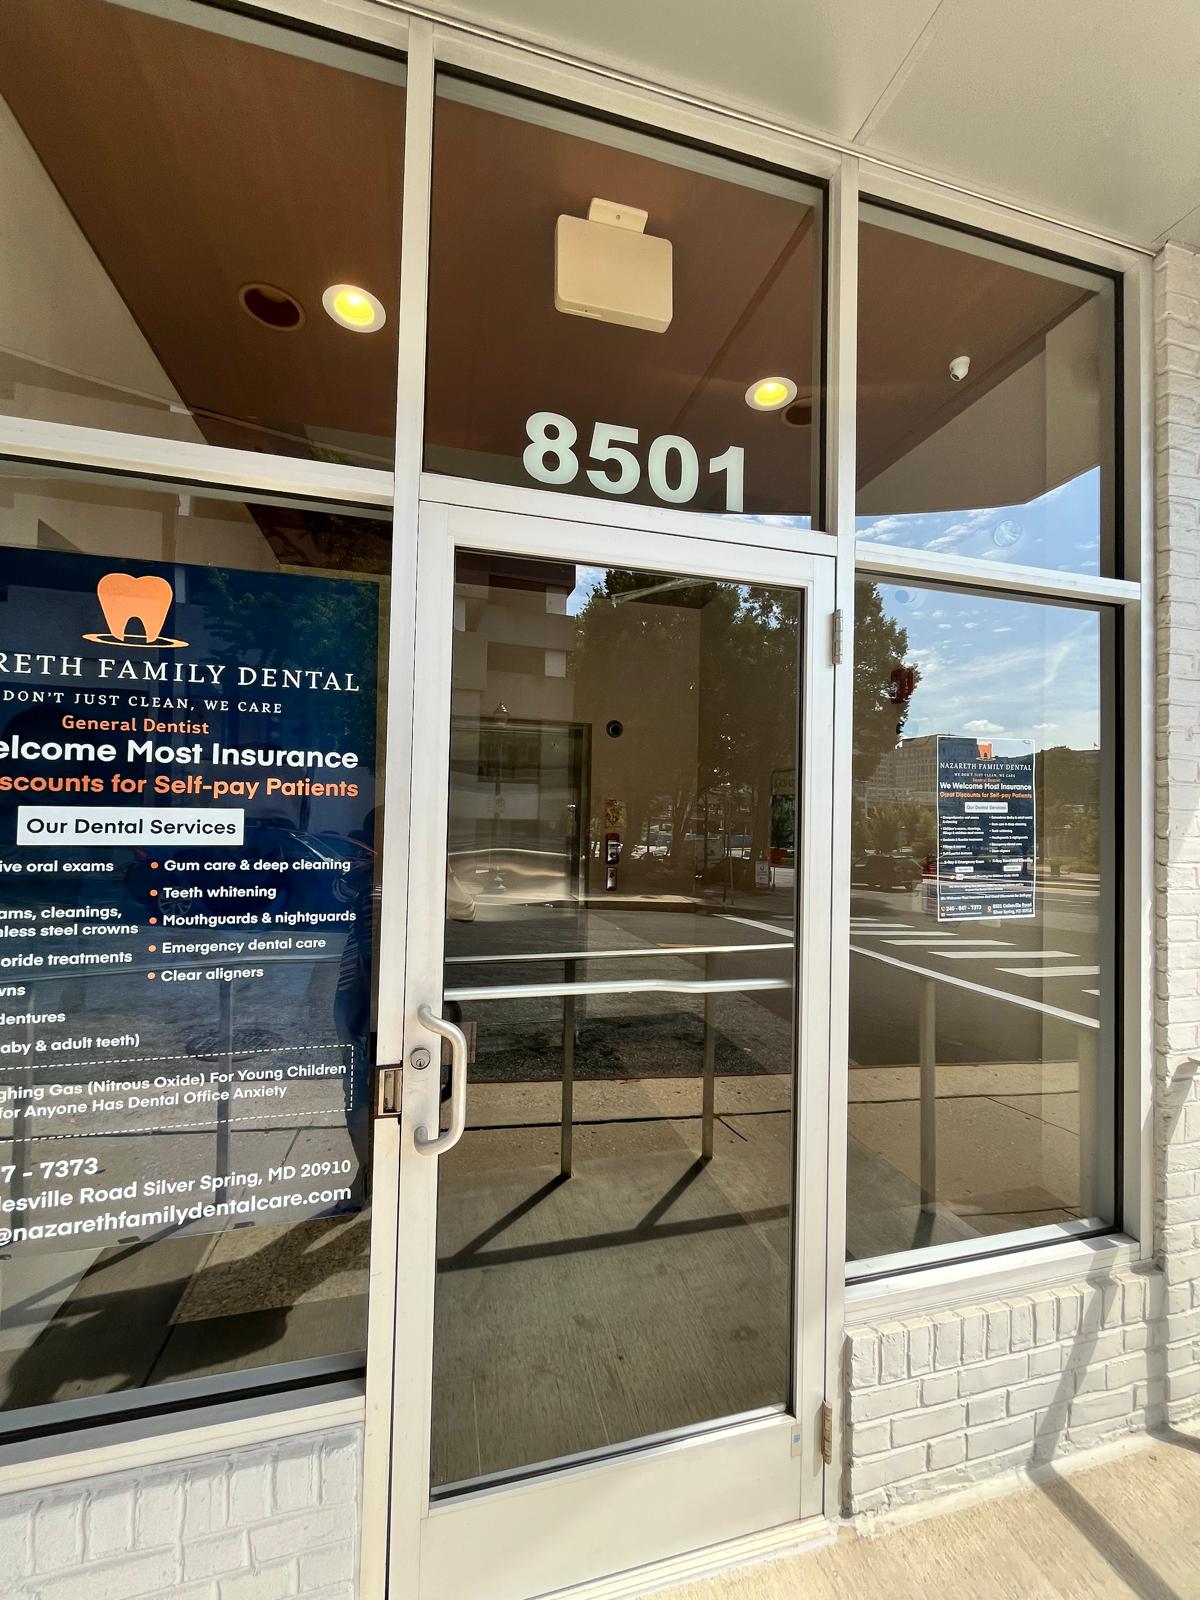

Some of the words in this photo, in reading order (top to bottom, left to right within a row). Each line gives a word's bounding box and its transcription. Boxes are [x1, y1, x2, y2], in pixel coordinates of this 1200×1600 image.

[522, 411, 744, 512] 8501
[97, 658, 226, 685] FAMILY
[237, 666, 360, 692] DENTAL
[2, 690, 65, 703] DON'T
[74, 693, 120, 706] JUST
[128, 695, 194, 711] CLEAN,
[203, 699, 229, 711] WE
[237, 701, 282, 714] CARE
[62, 714, 137, 732] General
[143, 718, 209, 735] Dentist
[127, 739, 203, 764] Most
[212, 742, 359, 769] Insurance
[940, 762, 977, 770] NAZARETH
[0, 775, 104, 793] scounts
[111, 773, 147, 793] for
[154, 775, 260, 800] Self-pay
[266, 777, 359, 797] Patients
[952, 782, 983, 790] Welcome
[1001, 783, 1032, 791] Insurance
[26, 818, 68, 834] Our
[74, 818, 143, 834] Dental
[150, 819, 236, 835] Services
[26, 859, 58, 873] oral
[62, 862, 114, 872] exams
[164, 859, 200, 871] Gum
[203, 861, 237, 871] care
[239, 859, 250, 871] &
[253, 858, 289, 873] deep
[293, 859, 351, 873] cleaning
[162, 886, 203, 899] Teeth
[206, 885, 277, 900] whitening
[40, 905, 122, 920] cleanings,
[162, 912, 259, 928] Mouthguards
[261, 912, 272, 924] &
[275, 910, 357, 926] nightguards
[40, 923, 78, 937] steel
[81, 924, 139, 936] crowns
[162, 942, 245, 955] Emergency
[247, 937, 292, 951] dental
[295, 939, 327, 949] care
[0, 953, 44, 968] oride
[47, 951, 133, 966] treatments
[160, 969, 203, 982] Clear
[205, 967, 264, 982] aligners
[1, 1041, 31, 1055] aby
[35, 1039, 47, 1052] &
[50, 1036, 93, 1051] adult
[95, 1033, 140, 1048] teeth)
[48, 1083, 83, 1097] Gas
[88, 1079, 150, 1096] (Nitrous
[154, 1073, 205, 1090] Oxide)
[210, 1072, 234, 1084] For
[237, 1069, 283, 1082] Young
[286, 1063, 347, 1078] Children
[23, 1103, 88, 1119] Anyone
[92, 1099, 124, 1112] Has
[128, 1092, 180, 1109] Dental
[183, 1089, 230, 1104] Office
[232, 1085, 288, 1100] Anxiety
[39, 1157, 98, 1179] 7373
[79, 1182, 137, 1204] Road
[143, 1179, 196, 1197] Silver
[199, 1171, 263, 1193] Spring,
[268, 1165, 296, 1182] MD
[300, 1159, 351, 1178] 20910
